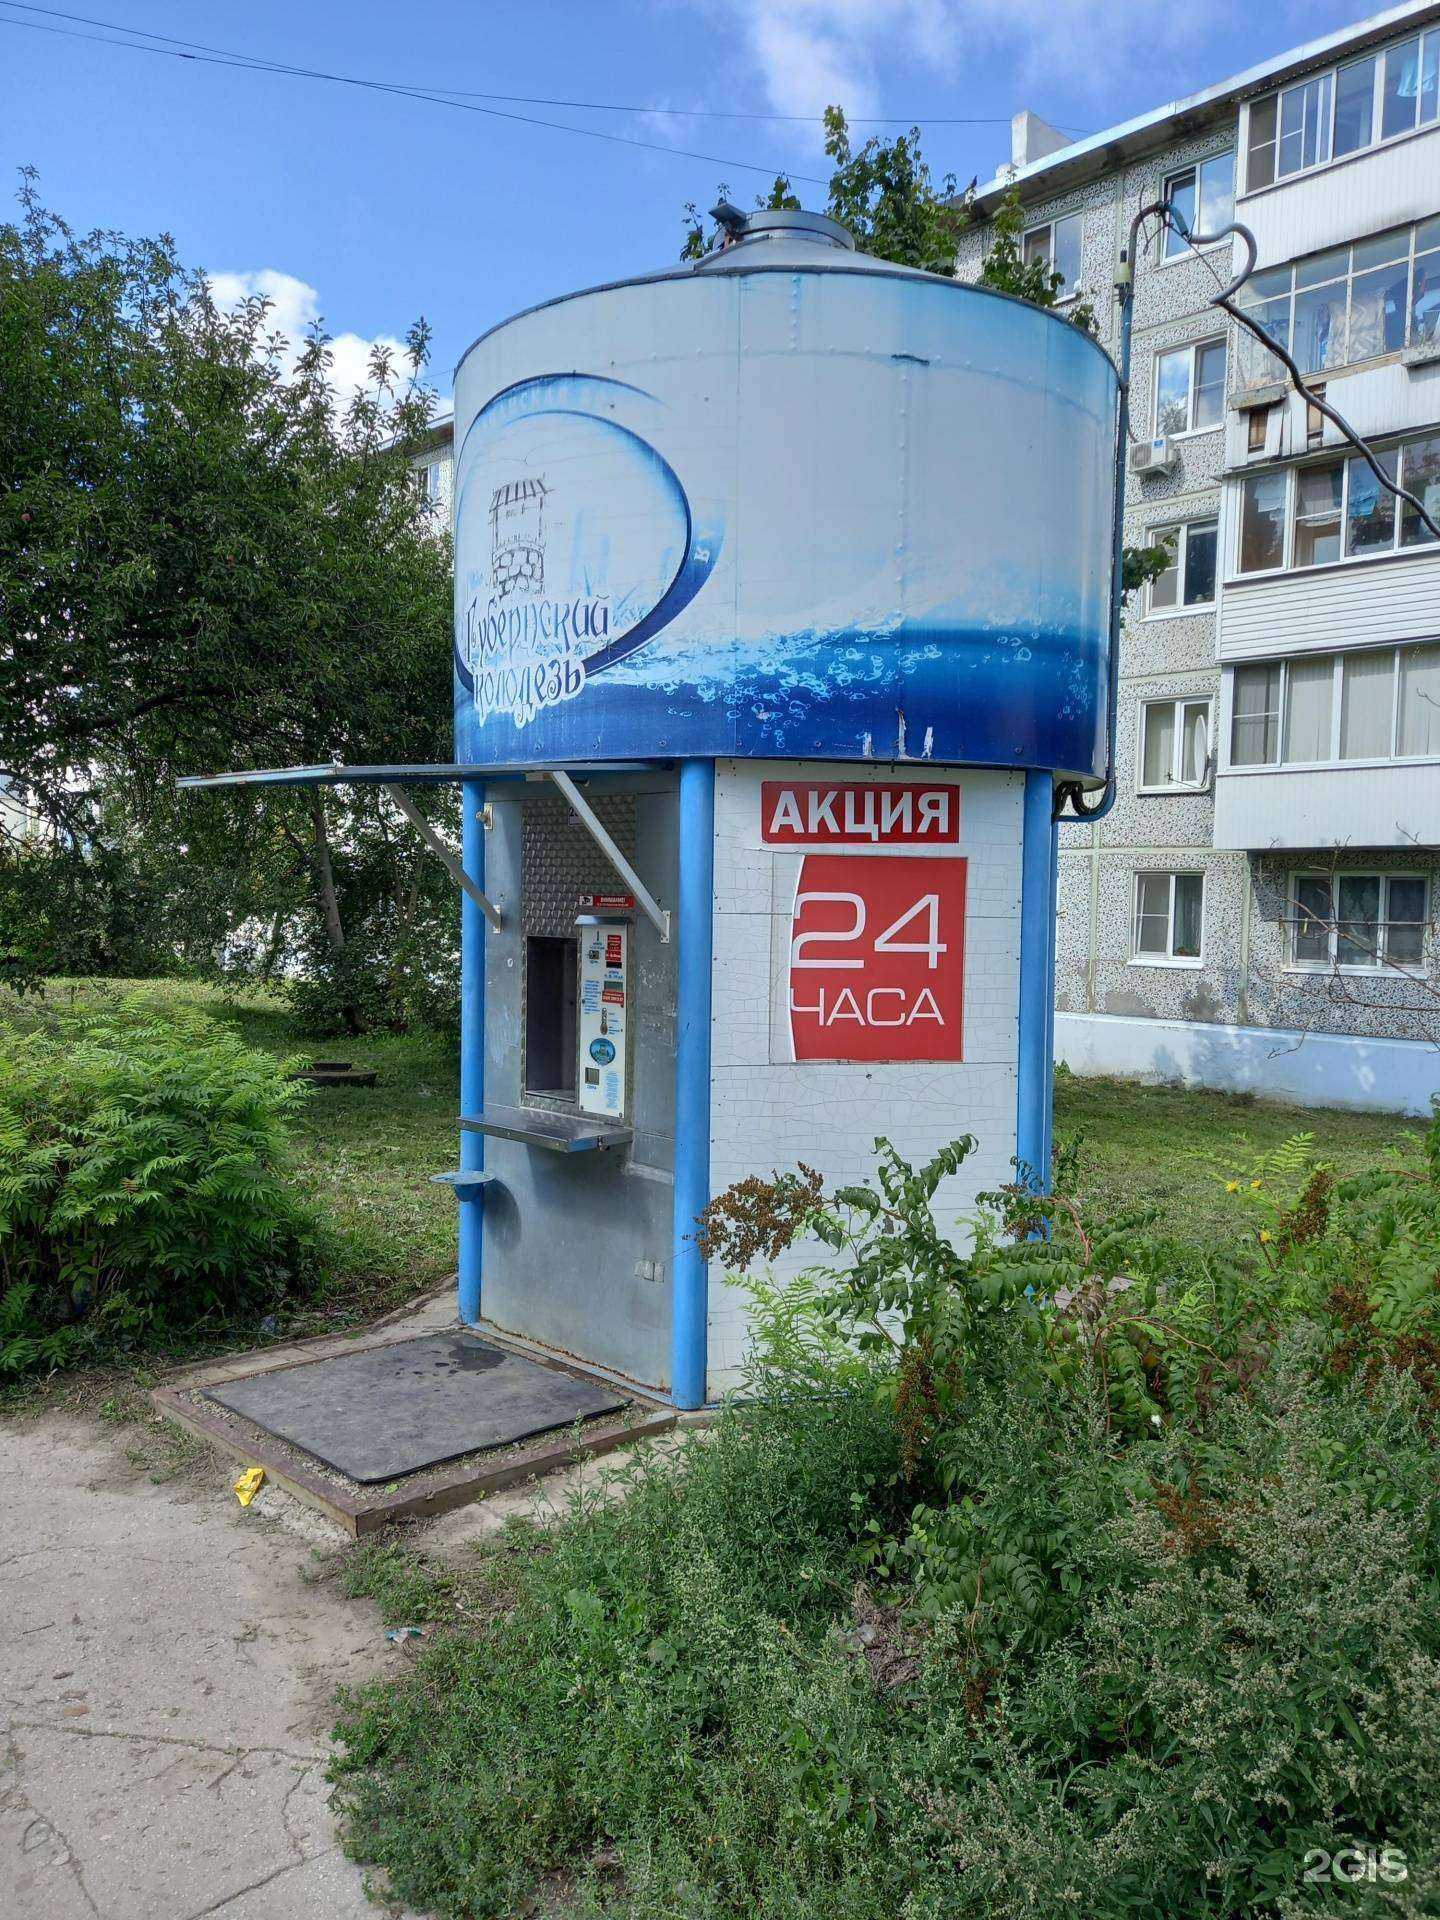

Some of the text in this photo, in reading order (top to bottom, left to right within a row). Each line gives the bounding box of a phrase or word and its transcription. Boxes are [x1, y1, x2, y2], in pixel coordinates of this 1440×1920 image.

[769, 790, 949, 842] АКЦИЯ
[790, 891, 948, 969] 24
[790, 987, 945, 1026] ЧАСА
